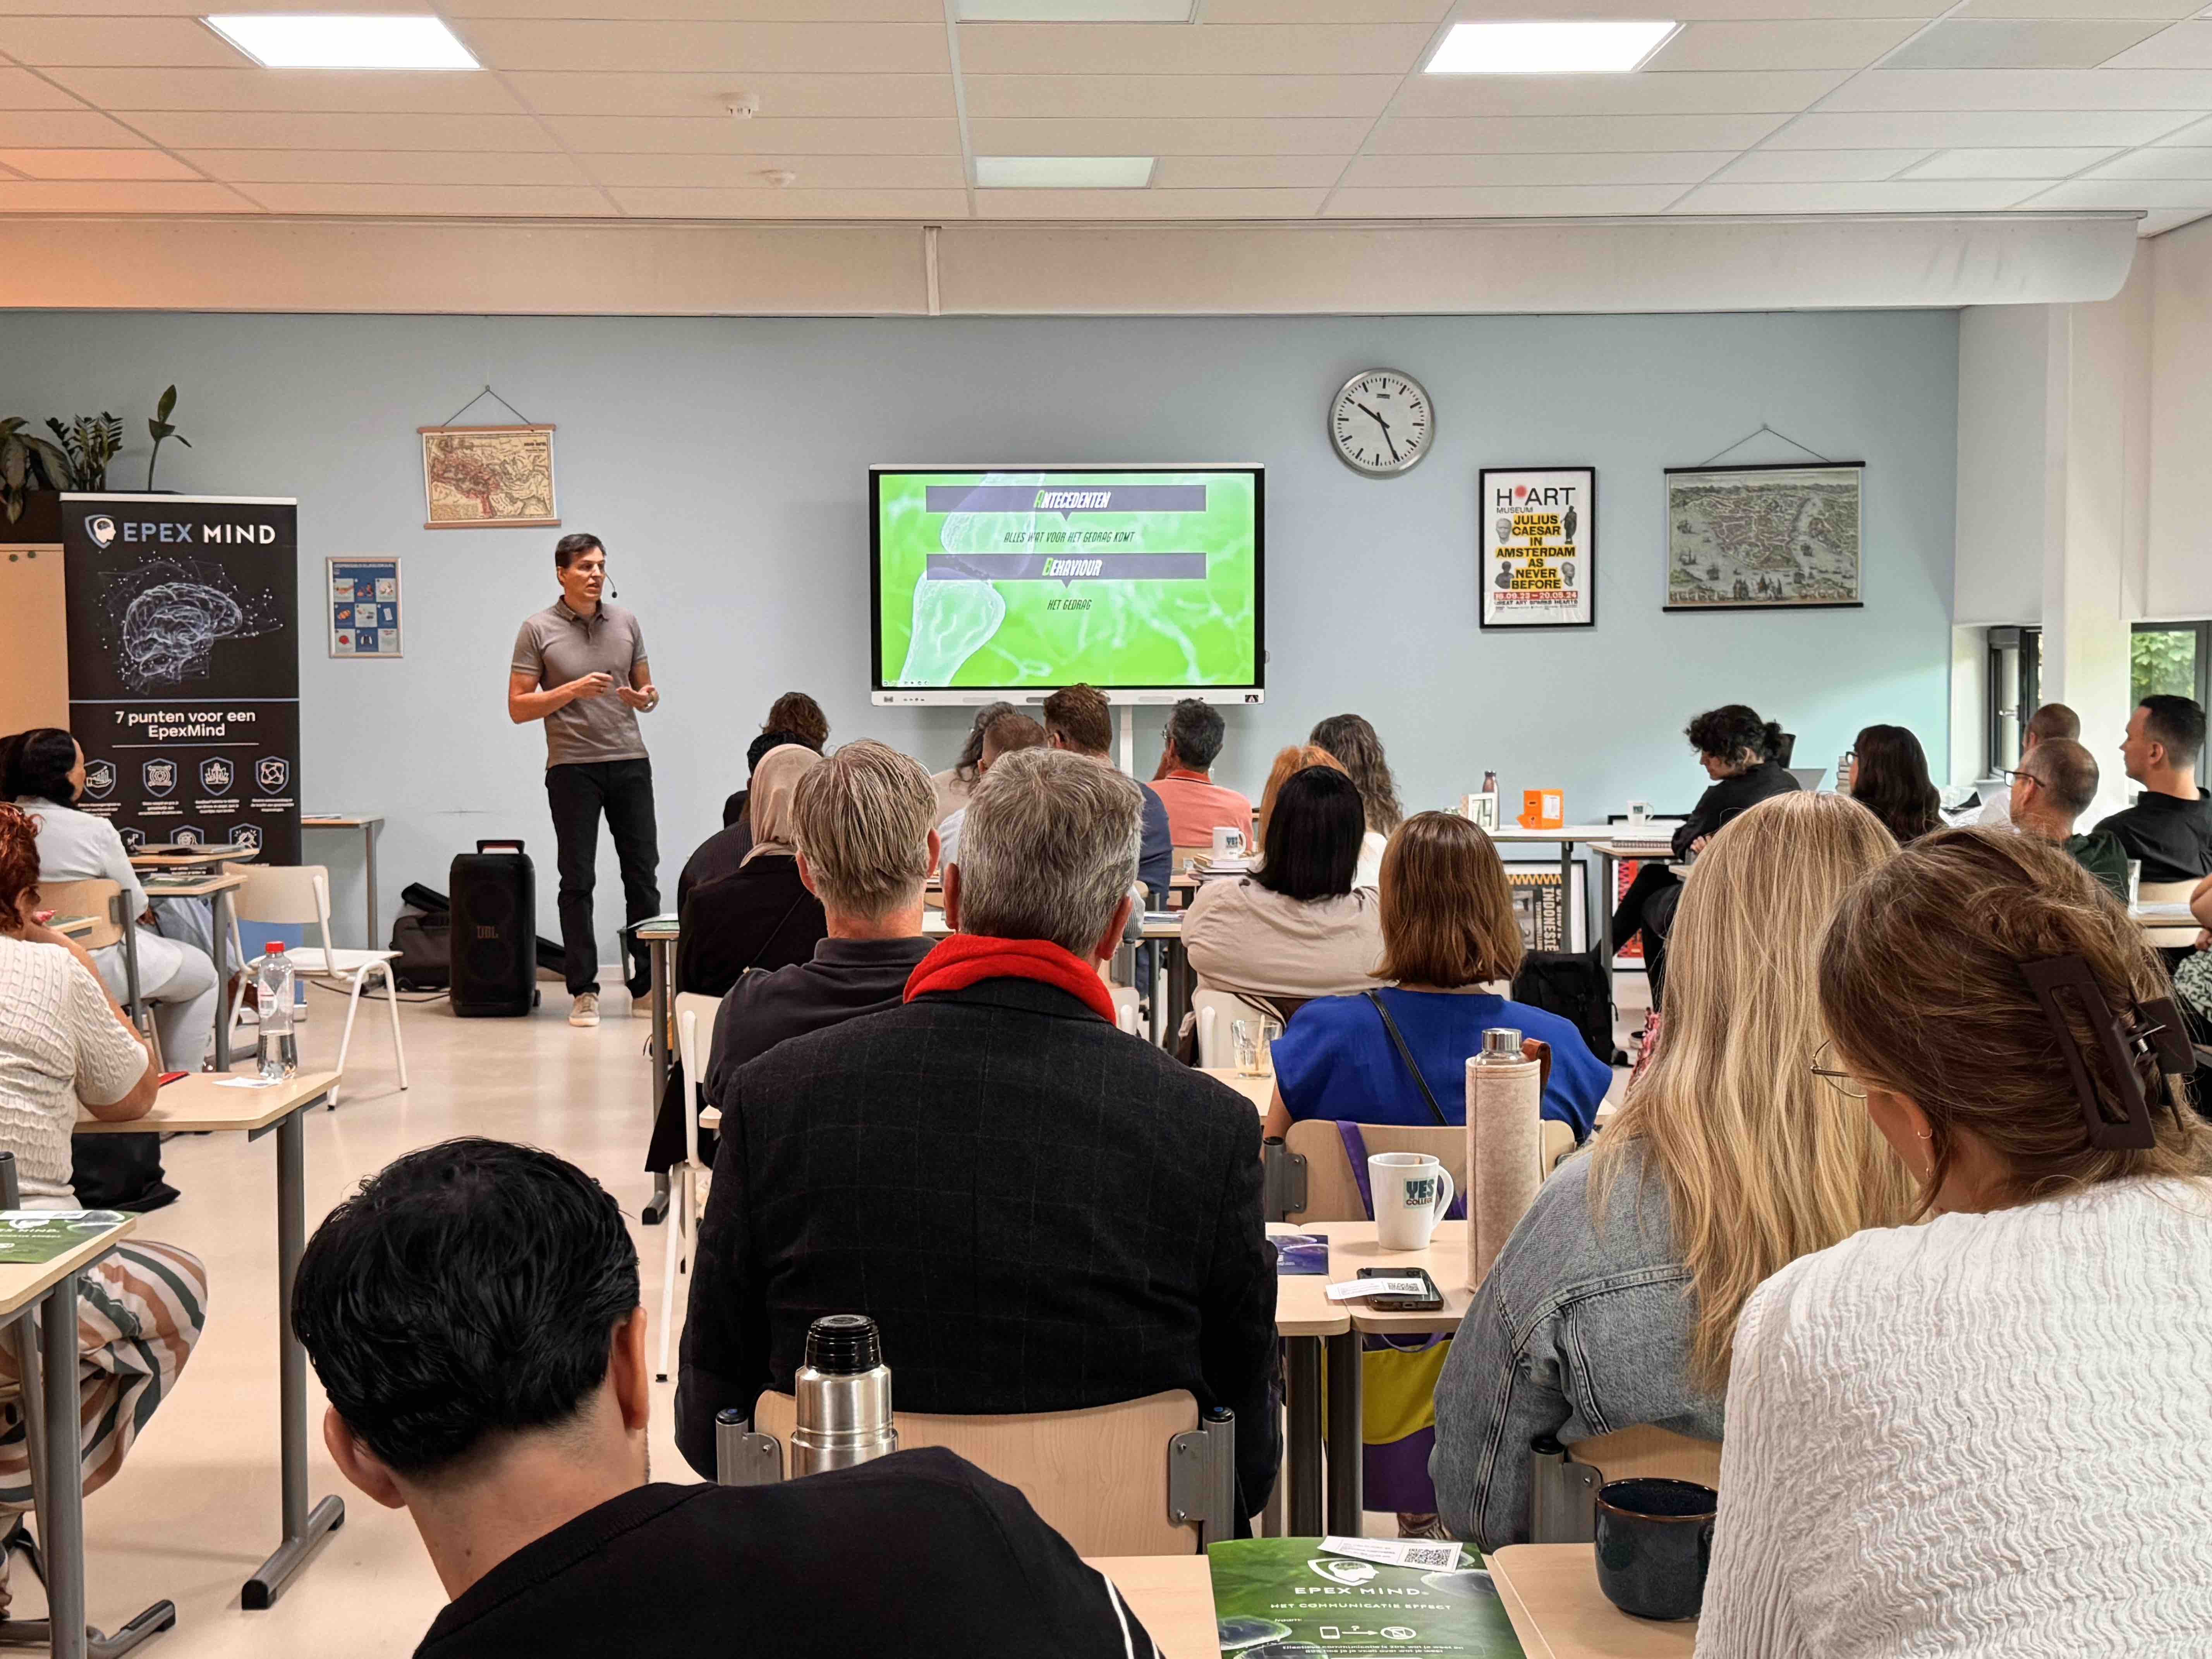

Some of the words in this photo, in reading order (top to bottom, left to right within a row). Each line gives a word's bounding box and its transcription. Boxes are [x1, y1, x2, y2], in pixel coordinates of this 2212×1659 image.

[1034, 490, 1111, 508] ANTECEDENTEN
[1514, 515, 1558, 525] JULIUS
[124, 522, 192, 543] EPEX
[203, 524, 276, 544] MIND
[1512, 526, 1561, 536] CAESAR
[1004, 532, 1026, 543] ALLES
[1028, 532, 1044, 543] WAT
[1046, 532, 1066, 543] VOOR
[1068, 532, 1082, 543] HET
[1084, 532, 1113, 543] GEDRAG
[1113, 532, 1135, 543] KOMT
[1530, 537, 1542, 546] IN
[1496, 547, 1575, 558] AMSTERDAM
[1042, 557, 1103, 576] BEHAVIOUR
[1528, 558, 1543, 567] AS
[1516, 569, 1557, 579] NEVER
[1512, 580, 1561, 589] BEFORE
[1047, 599, 1061, 610] HET
[1063, 599, 1092, 610] GEDRAG
[115, 711, 125, 723] 7
[128, 711, 184, 726] punten
[188, 712, 223, 722] voor
[227, 711, 256, 721] een
[148, 723, 225, 740] EpexMind
[477, 925, 499, 939] JBL
[1406, 1179, 1434, 1199] YES
